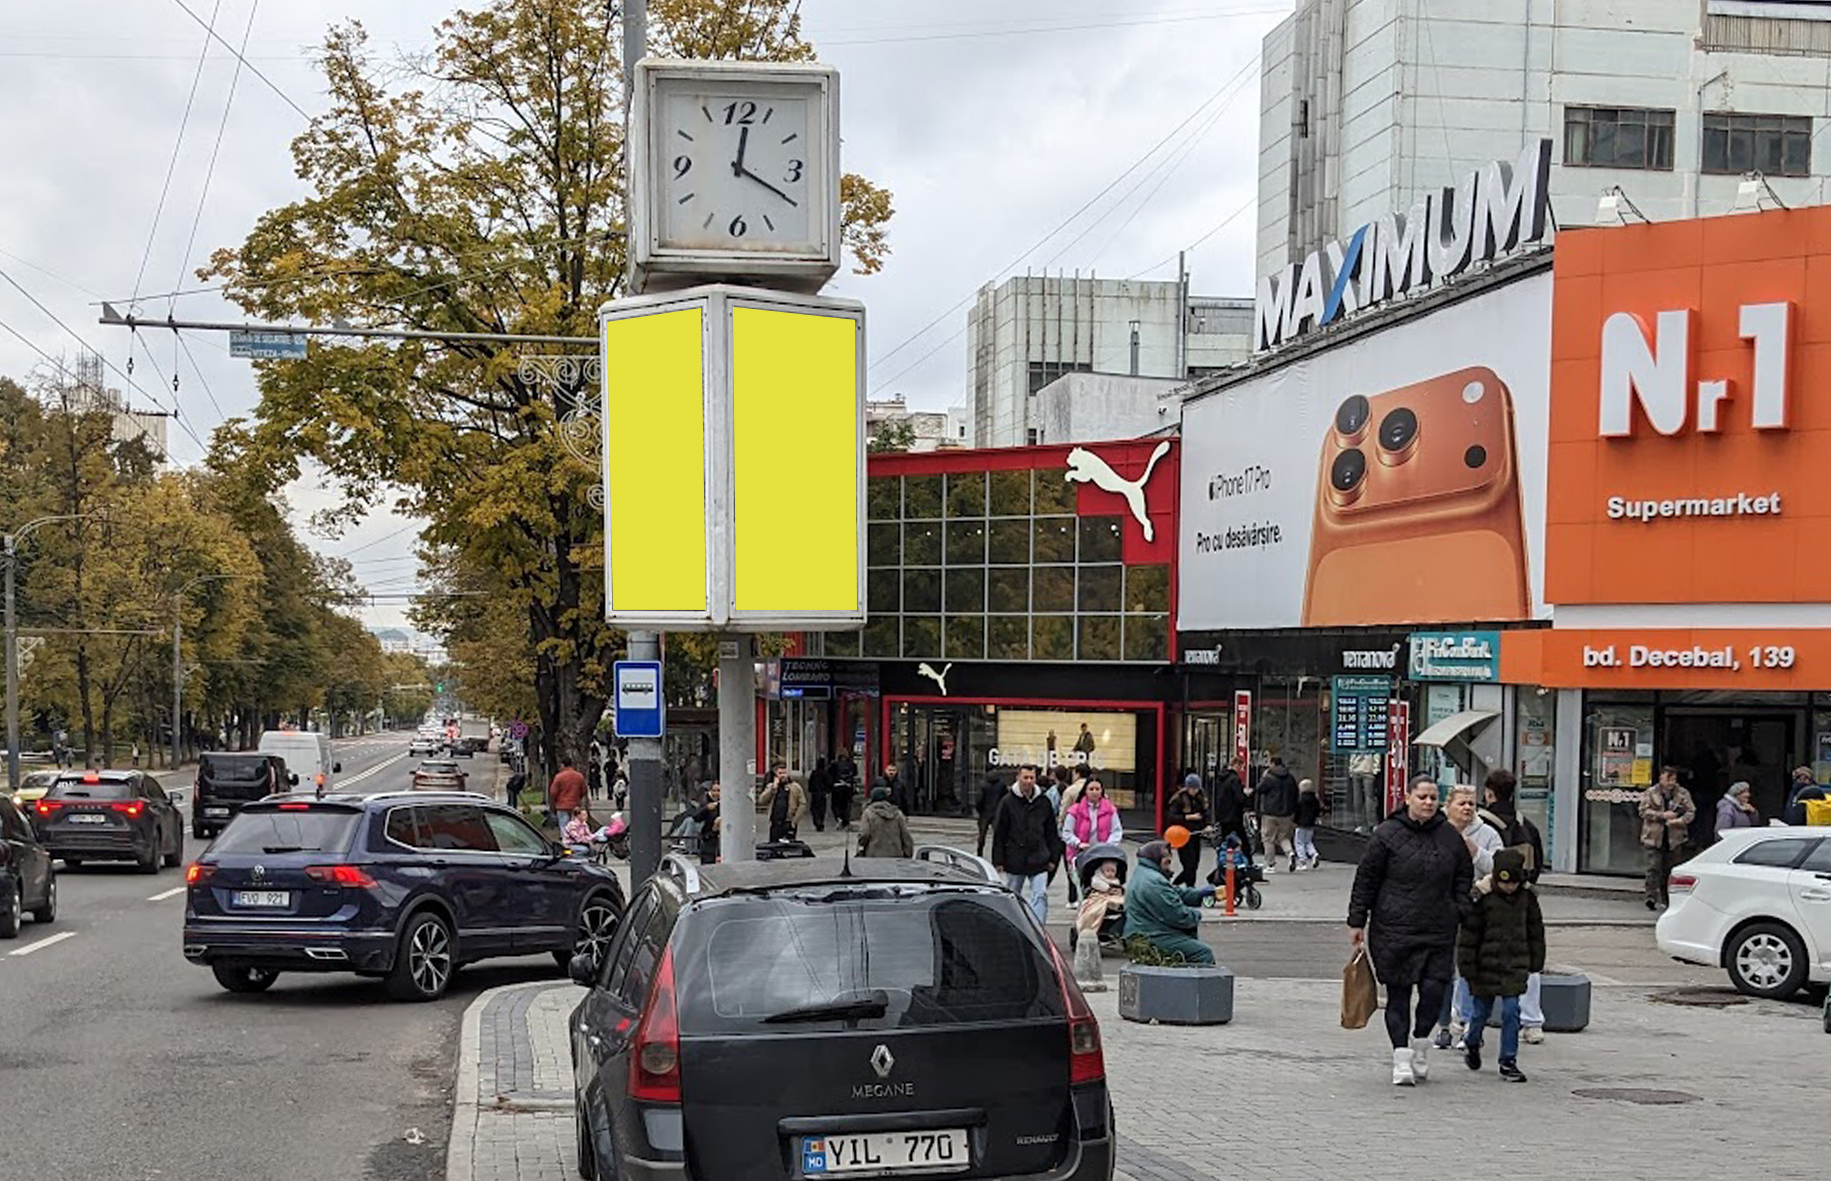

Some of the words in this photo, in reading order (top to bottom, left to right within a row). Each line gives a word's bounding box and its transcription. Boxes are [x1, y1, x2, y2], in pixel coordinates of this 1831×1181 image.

[723, 101, 757, 125] 12
[673, 155, 692, 181] 9
[782, 159, 804, 183] 3
[728, 215, 747, 237] 6
[1255, 139, 1553, 351] MAXIMUM
[1255, 465, 1271, 491] Pro
[1607, 492, 1781, 522] Supermarket
[1196, 532, 1211, 554] Pro
[1212, 533, 1223, 552] cu
[1583, 645, 1621, 666] bd.
[1630, 645, 1740, 671] Decebal,
[1749, 646, 1795, 668] 139
[267, 892, 283, 905] 921
[851, 1083, 915, 1098] MEGANE
[807, 1155, 824, 1168] MD
[828, 1139, 881, 1166] YIL
[904, 1133, 954, 1163] 770
